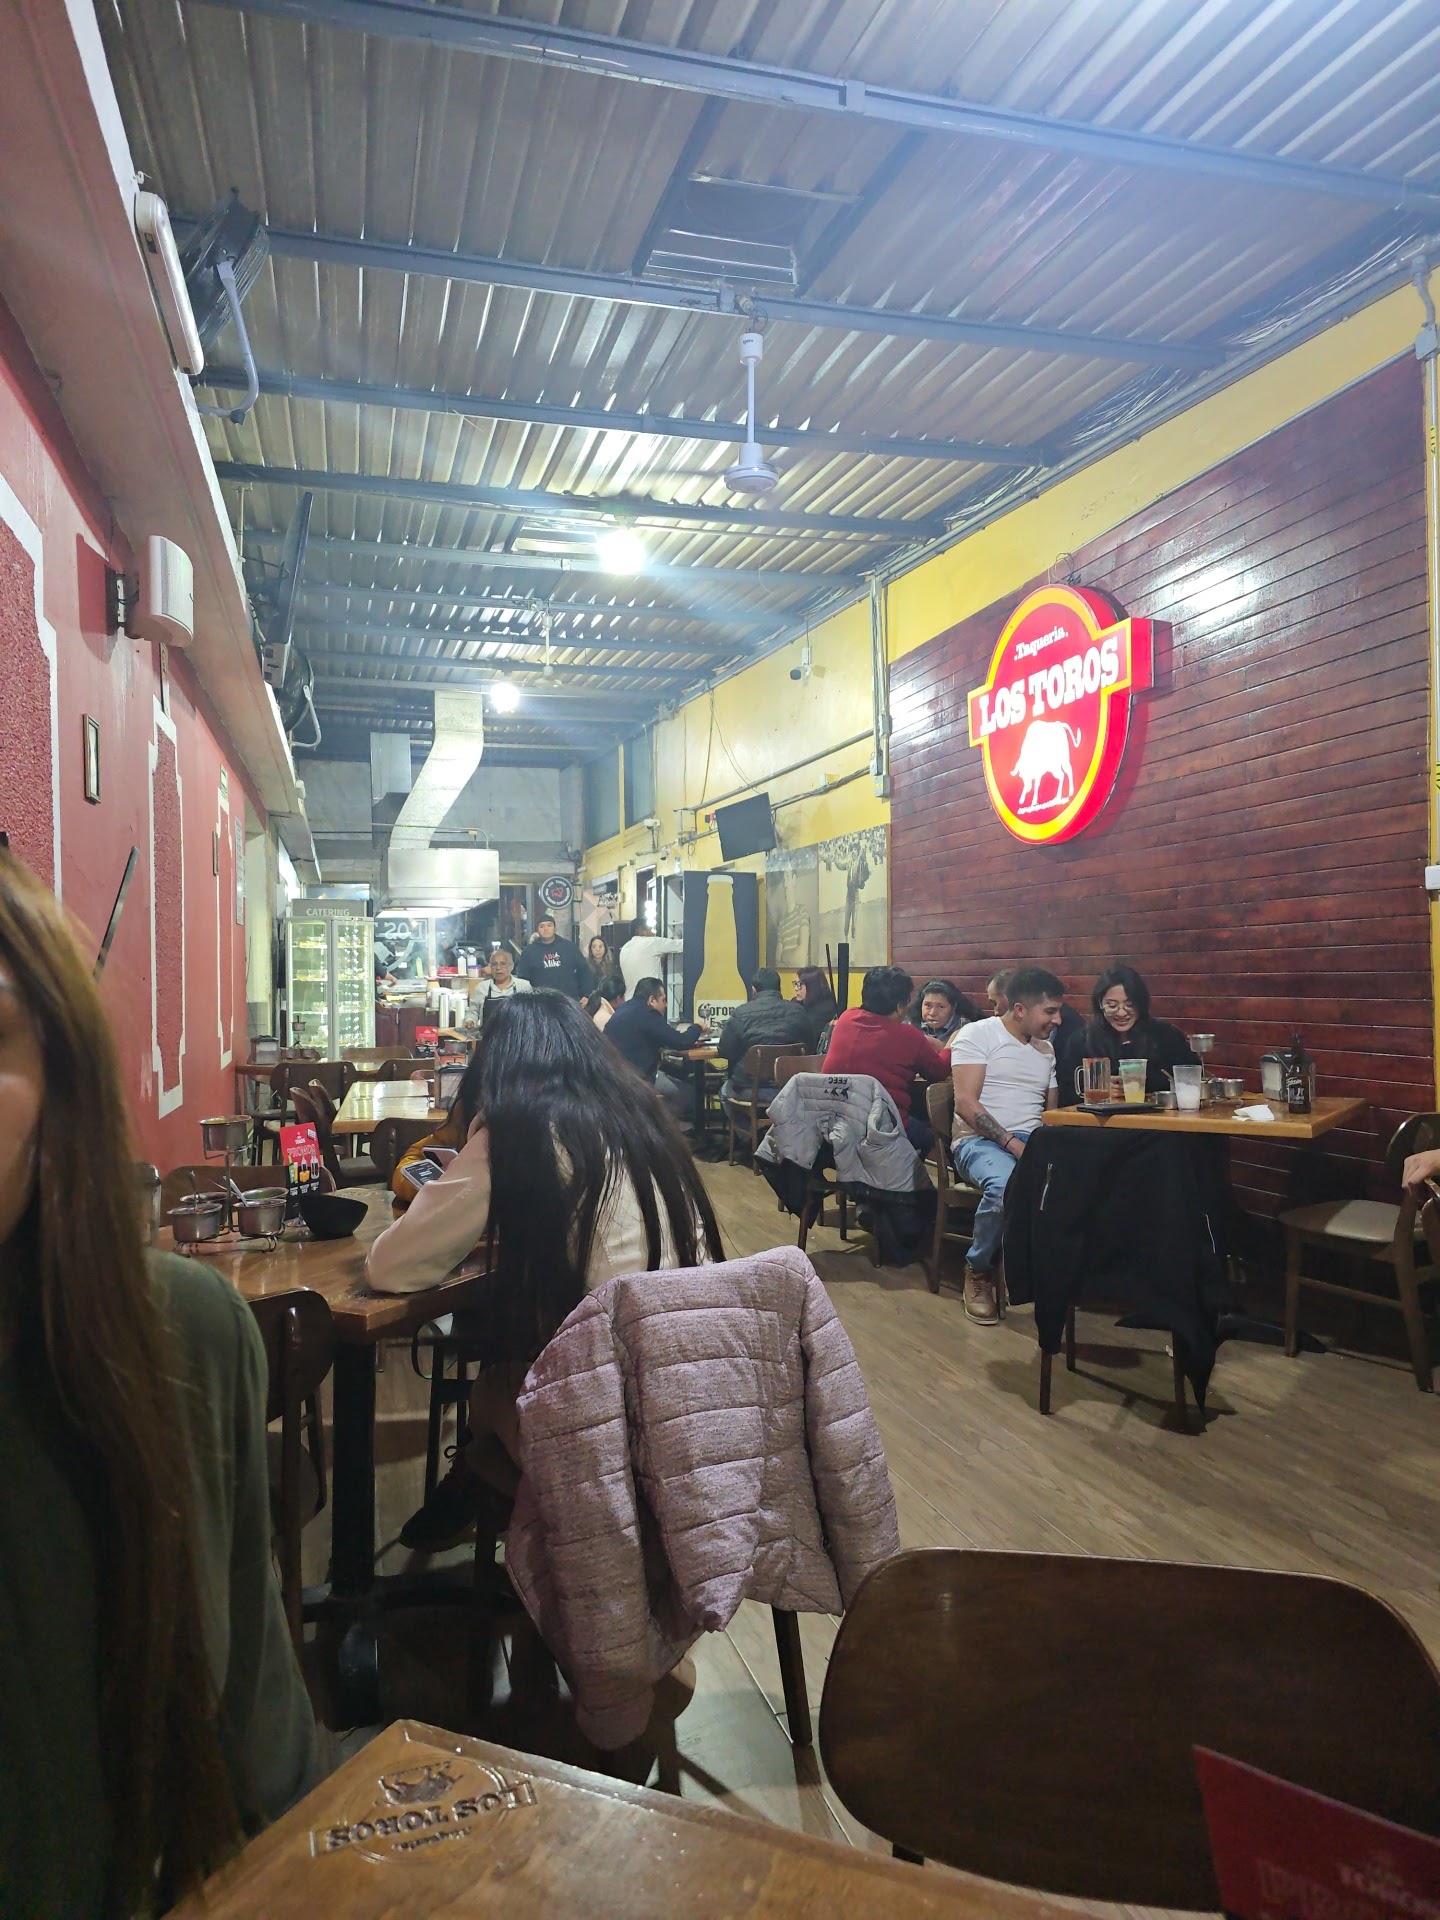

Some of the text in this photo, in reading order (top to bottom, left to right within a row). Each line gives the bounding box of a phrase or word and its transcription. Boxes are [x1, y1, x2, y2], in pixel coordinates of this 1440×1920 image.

[979, 637, 1119, 737] LOS TOROS
[306, 907, 350, 917] CATERING
[698, 1002, 736, 1018] Coron
[325, 1805, 449, 1850] TOROS
